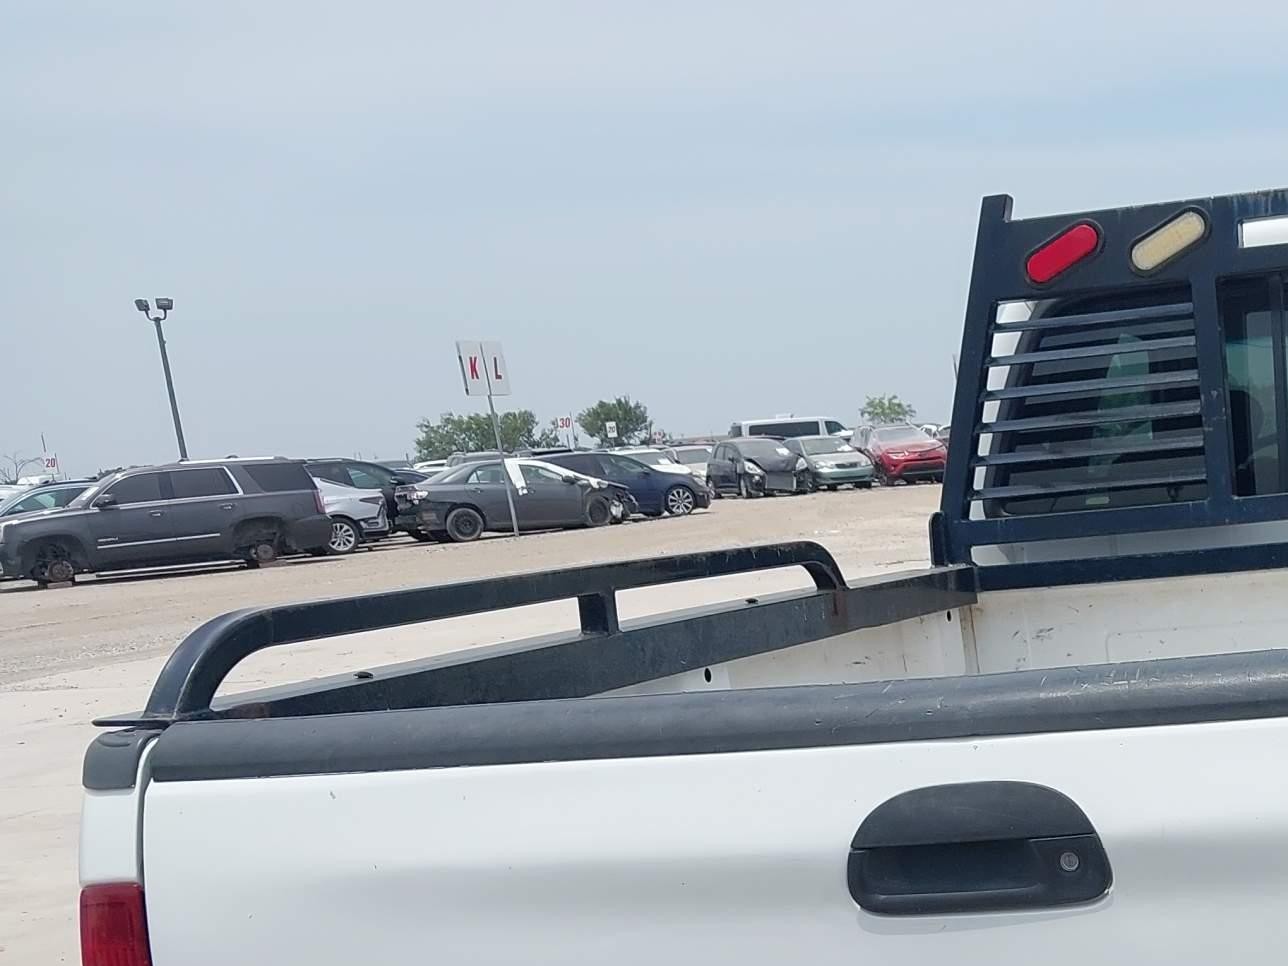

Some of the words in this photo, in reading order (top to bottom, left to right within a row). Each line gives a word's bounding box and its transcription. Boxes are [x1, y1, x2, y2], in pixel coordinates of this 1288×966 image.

[469, 356, 480, 380] K
[493, 356, 503, 380] L
[559, 417, 571, 429] 30
[45, 458, 56, 468] 20
